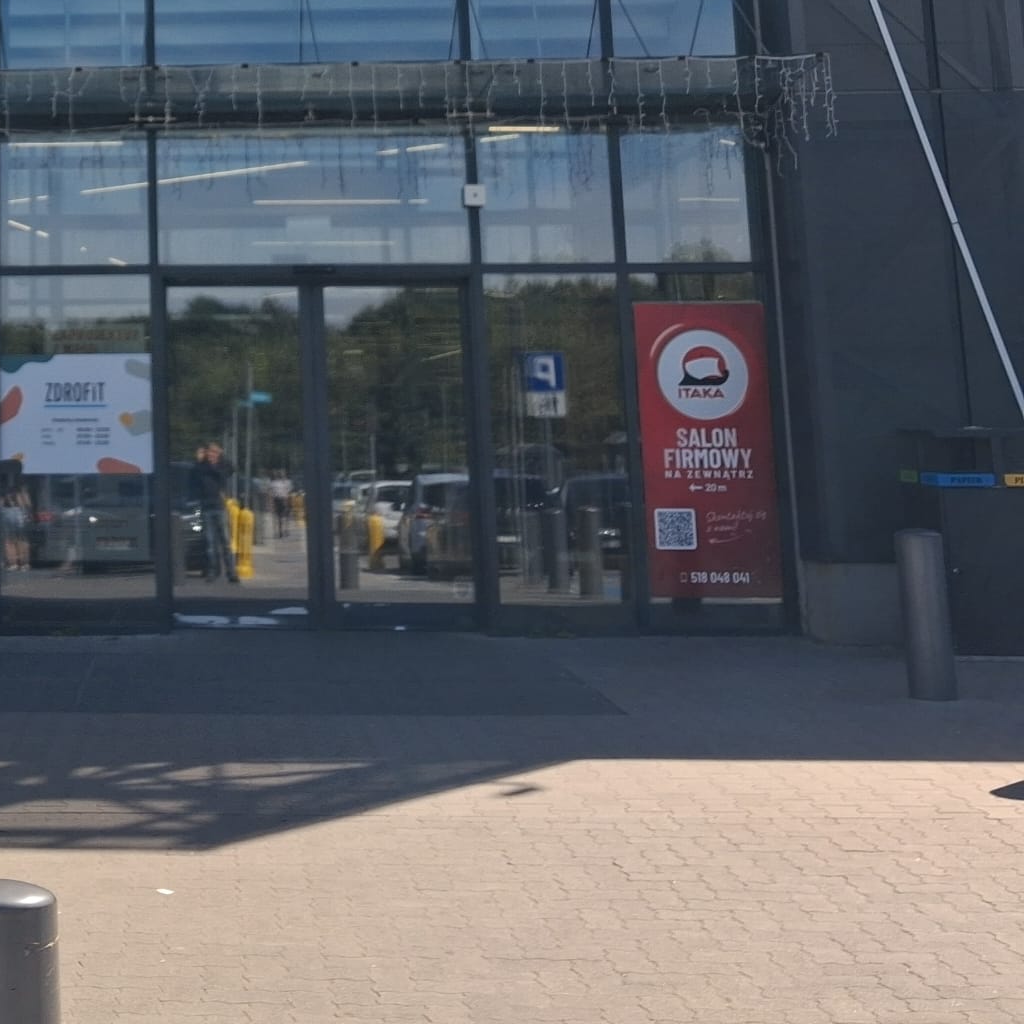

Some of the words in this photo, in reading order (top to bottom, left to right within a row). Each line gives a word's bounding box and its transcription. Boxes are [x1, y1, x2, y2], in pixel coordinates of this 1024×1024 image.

[678, 387, 725, 398] ITAKA
[676, 427, 738, 448] SALON
[664, 448, 753, 469] FIRMOWY
[664, 470, 682, 479] NA
